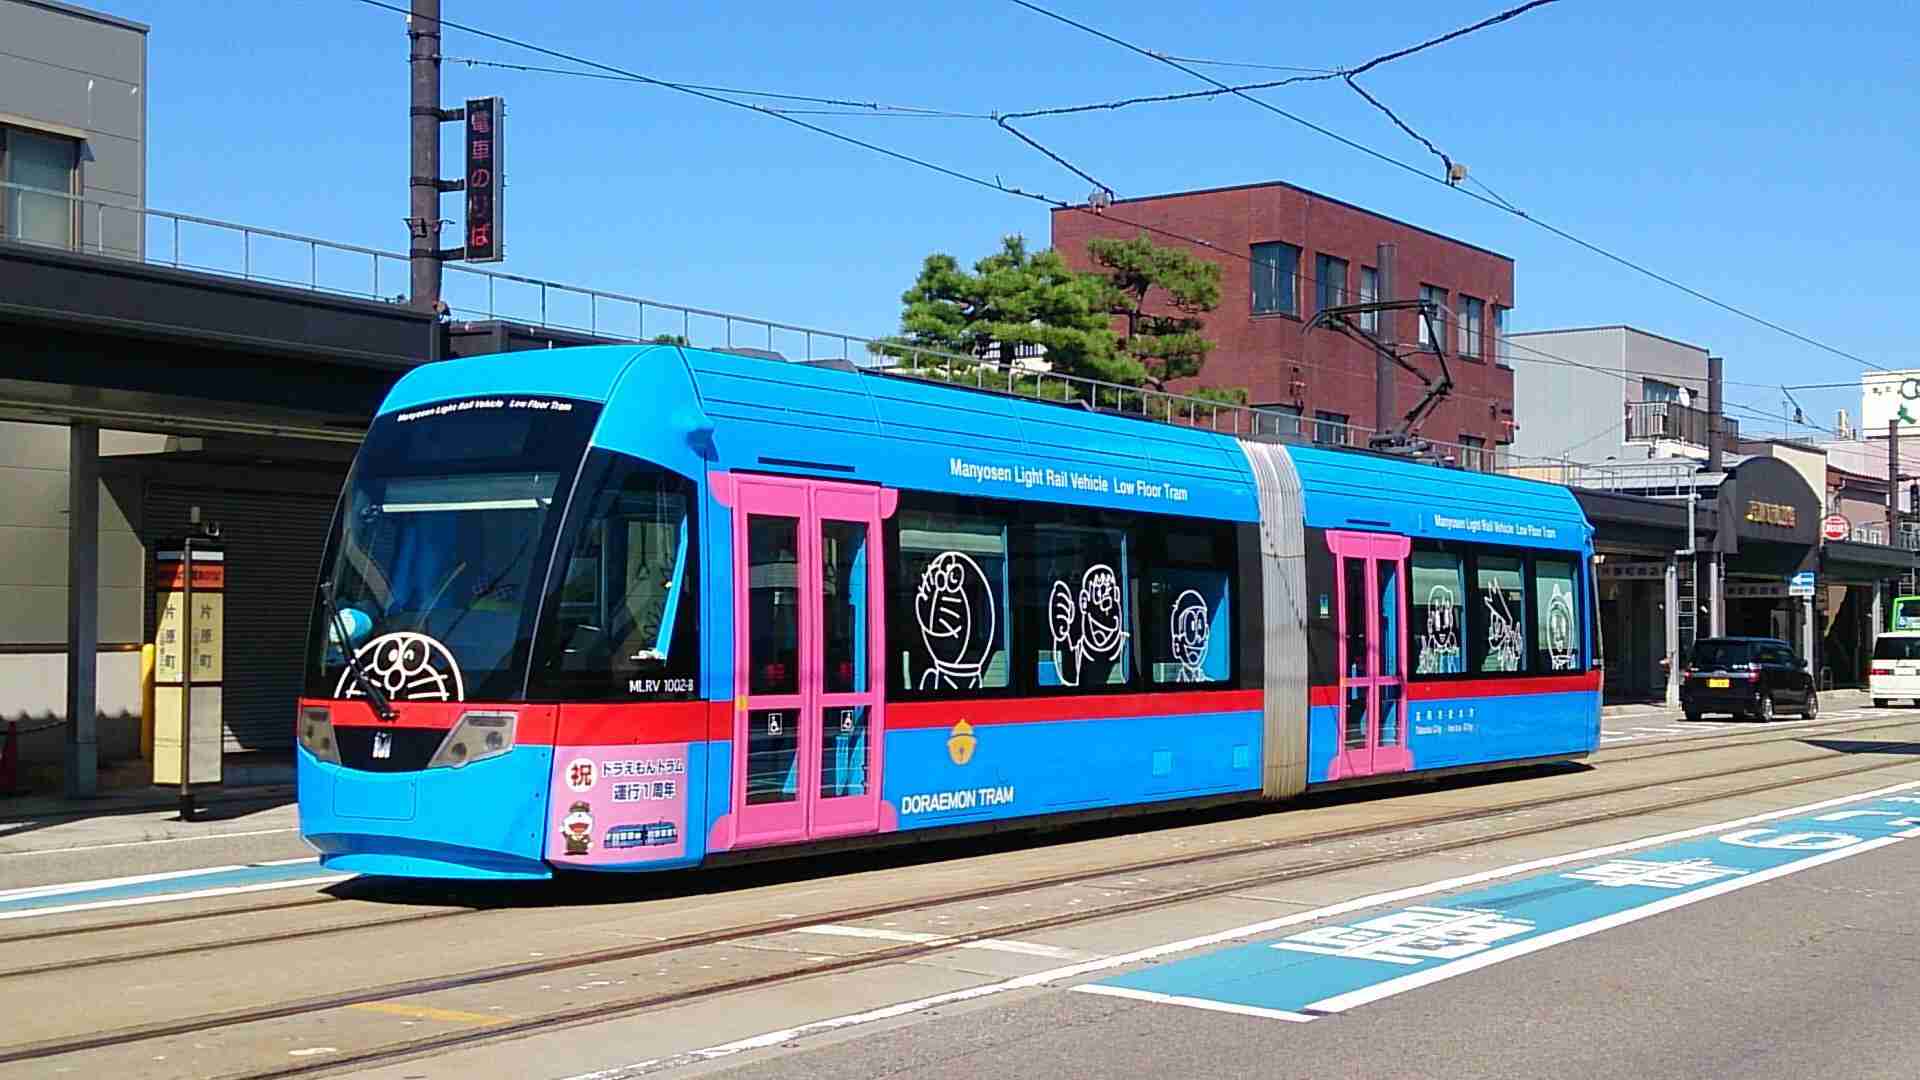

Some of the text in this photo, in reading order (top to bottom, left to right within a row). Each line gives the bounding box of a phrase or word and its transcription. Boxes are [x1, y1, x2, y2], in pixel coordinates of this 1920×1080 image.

[949, 458, 1188, 501] Manyosen Light Rail Vehicle Low Floor Tram
[629, 679, 661, 693] MLRV
[571, 763, 592, 787] 祝
[602, 759, 684, 777] ドラえもんトラム
[901, 786, 1015, 815] DORAEMON TRAM
